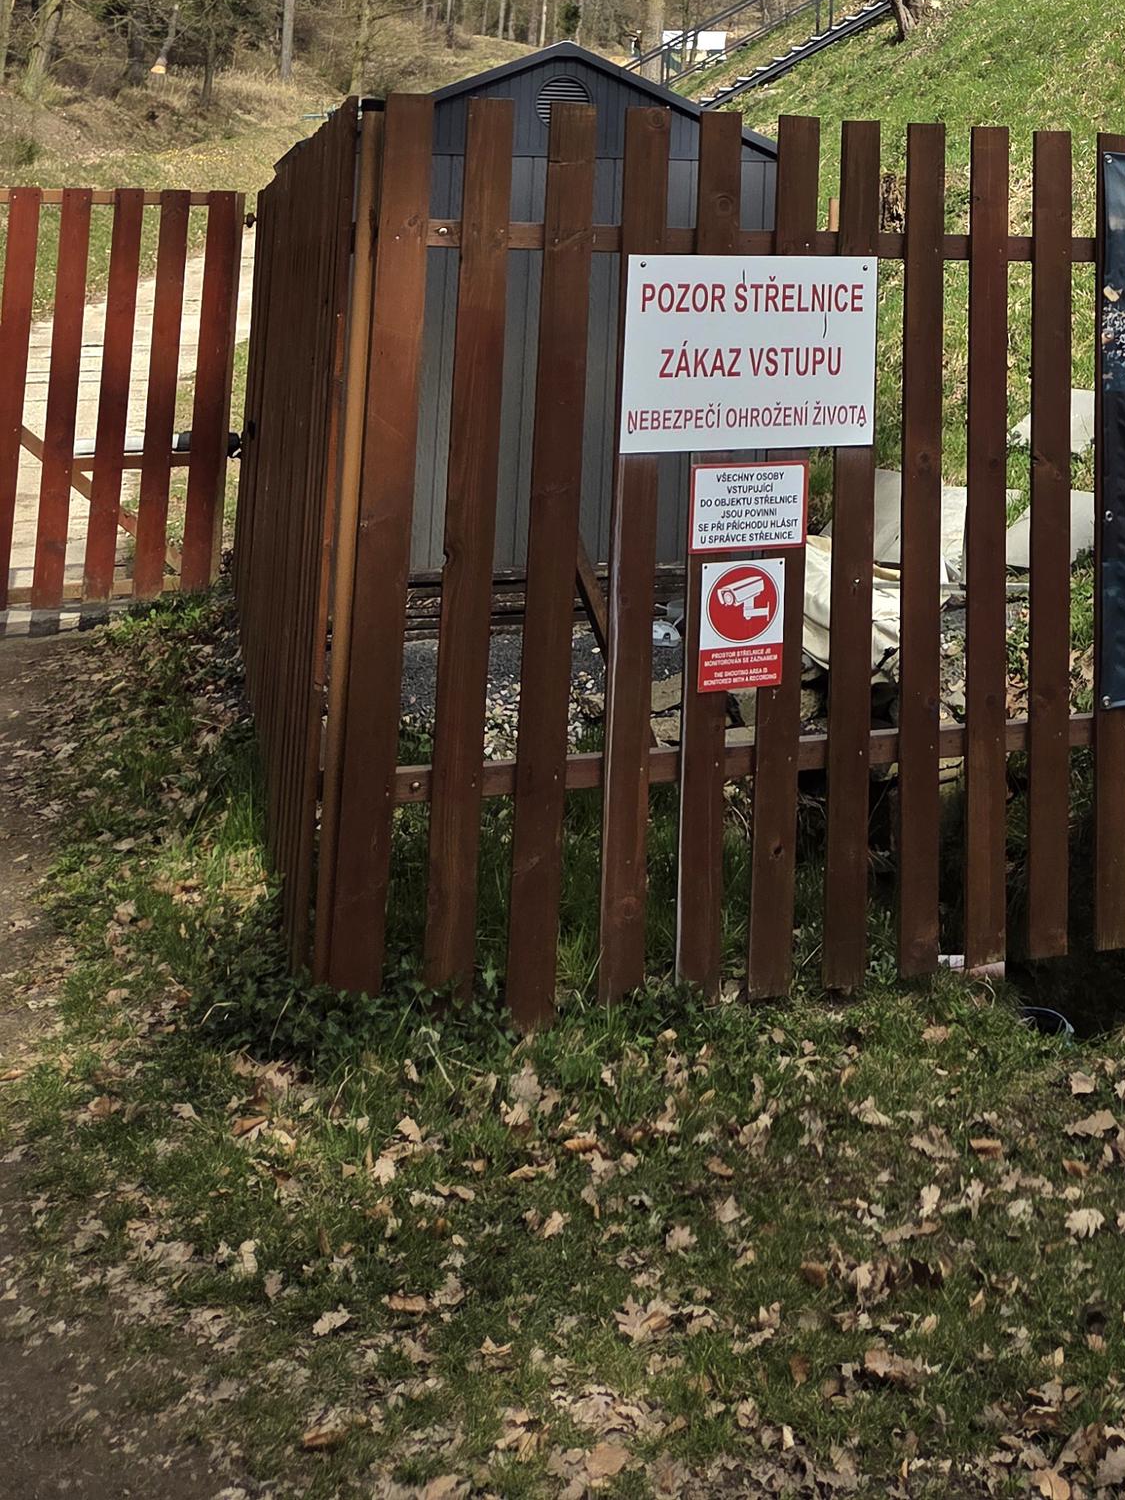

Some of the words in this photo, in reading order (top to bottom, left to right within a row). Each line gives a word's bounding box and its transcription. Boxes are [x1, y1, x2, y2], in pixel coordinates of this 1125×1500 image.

[641, 283, 726, 313] POZOR
[734, 275, 864, 313] STŘELNICE
[658, 340, 742, 378] ZÁKAZ
[750, 347, 842, 377] VSTUPU
[627, 403, 722, 431] NEBEZPEČÍ
[726, 401, 809, 428] OHROŽENÍ
[812, 401, 867, 426] ŽIVOTA
[716, 472, 755, 483] VŠECHNY
[756, 471, 785, 481] OSOBY
[726, 483, 773, 494] VSTUPUJÍCÍ
[700, 499, 713, 508] DO
[714, 497, 752, 507] OBJEKTU
[754, 494, 798, 505] STŘELNICE
[721, 509, 743, 519] JSOU
[745, 508, 777, 518] POVINNI
[698, 523, 709, 532] SE
[711, 521, 724, 531] PŘI
[726, 520, 768, 531] PŘÍCHODU
[770, 517, 798, 528] HLÁSIT
[700, 536, 707, 544] U
[708, 533, 747, 544] SPRÁVCE
